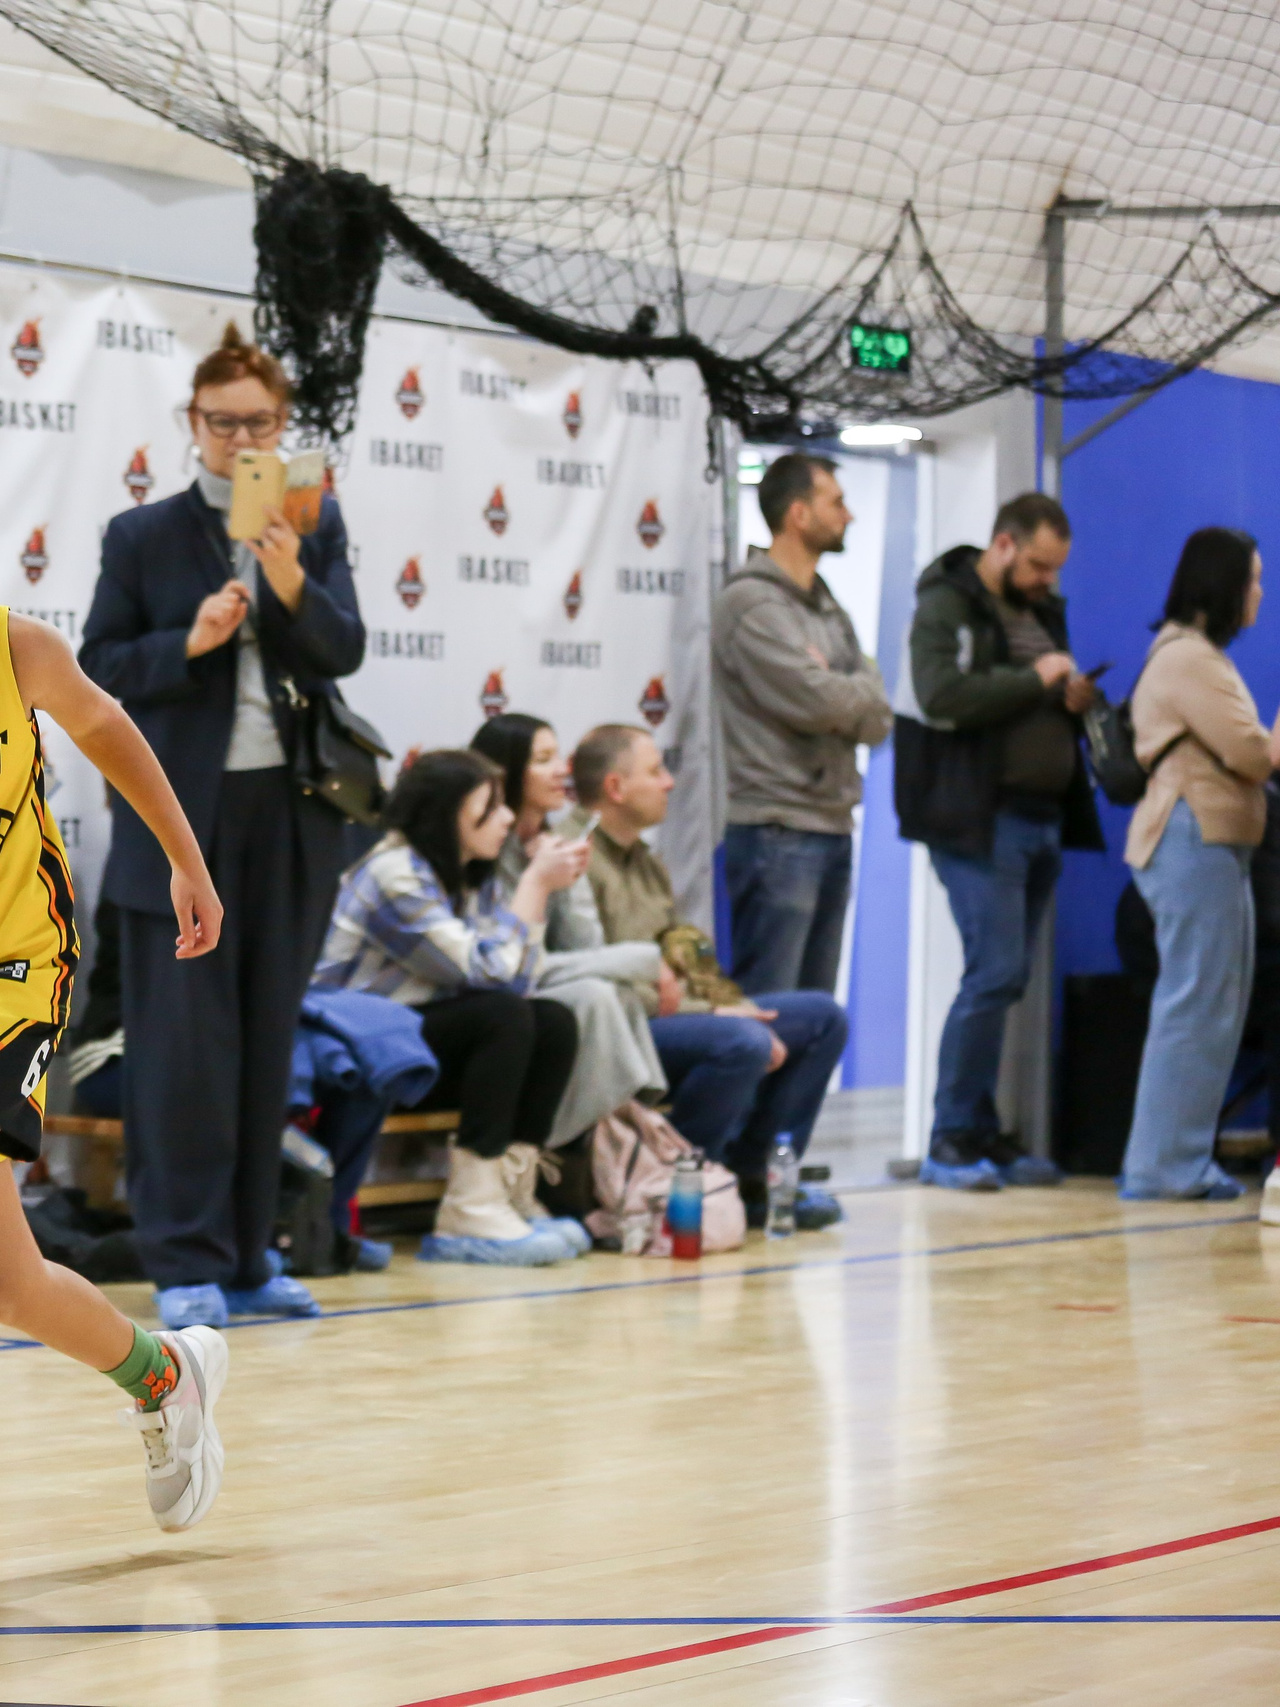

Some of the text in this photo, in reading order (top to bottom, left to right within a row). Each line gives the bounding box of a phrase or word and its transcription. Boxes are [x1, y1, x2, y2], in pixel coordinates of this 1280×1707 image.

[96, 320, 176, 355] IBASKET
[370, 438, 444, 473] IBASKET
[458, 554, 530, 586] IBASKET
[616, 567, 686, 597] IBASKET
[371, 630, 445, 662] IBASKET
[539, 639, 602, 670] IBASKET
[21, 1038, 51, 1099] 6
